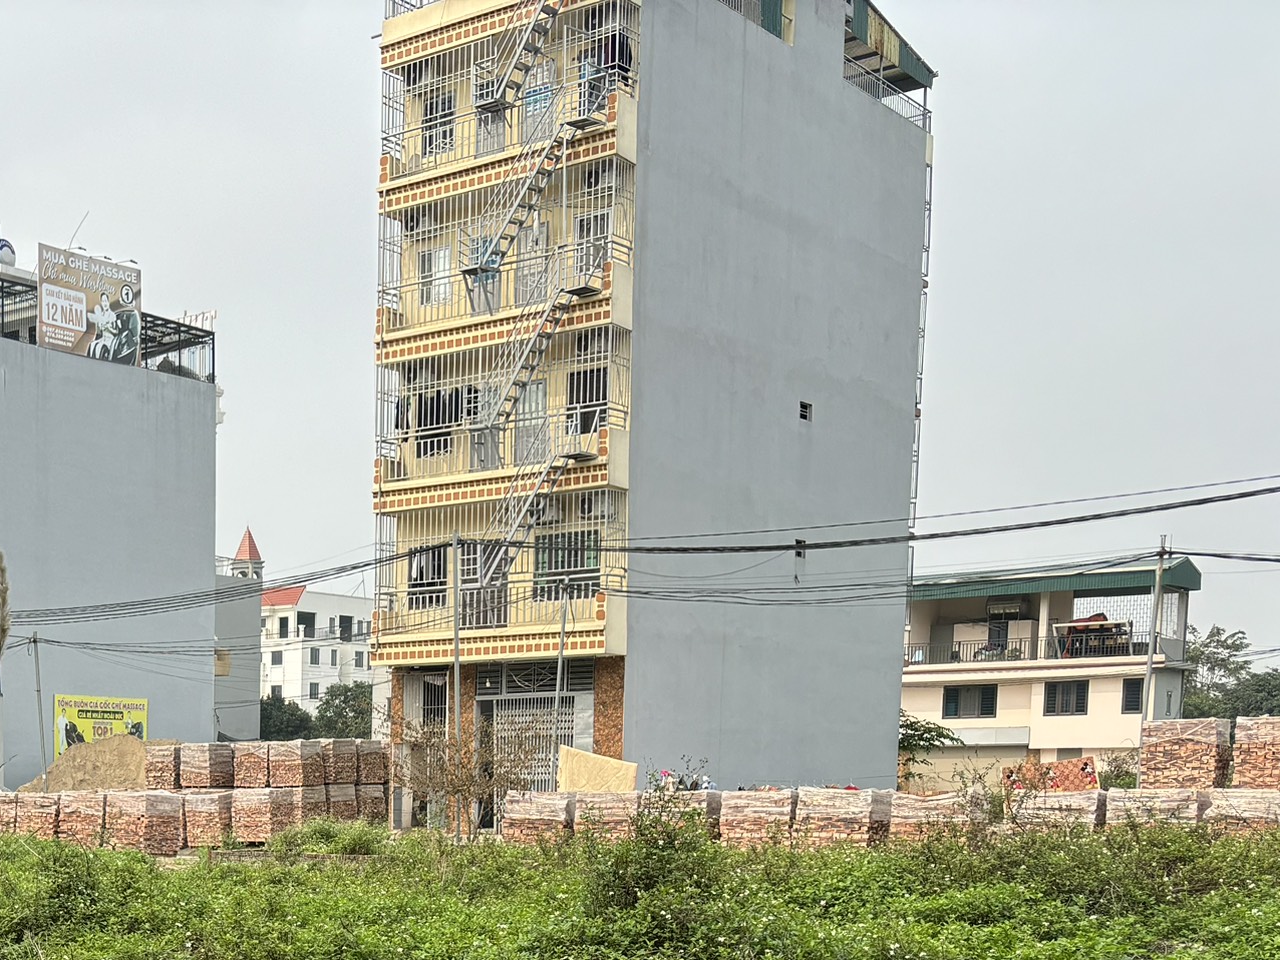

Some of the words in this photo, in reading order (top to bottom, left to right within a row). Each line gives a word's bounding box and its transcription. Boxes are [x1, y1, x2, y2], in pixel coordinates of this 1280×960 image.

[42, 249, 66, 266] MUA
[91, 263, 137, 283] MASSAGE
[46, 302, 58, 322] 12
[61, 304, 84, 328] NĂM
[122, 702, 145, 711] MASSAGE
[92, 726, 108, 736] TOP
